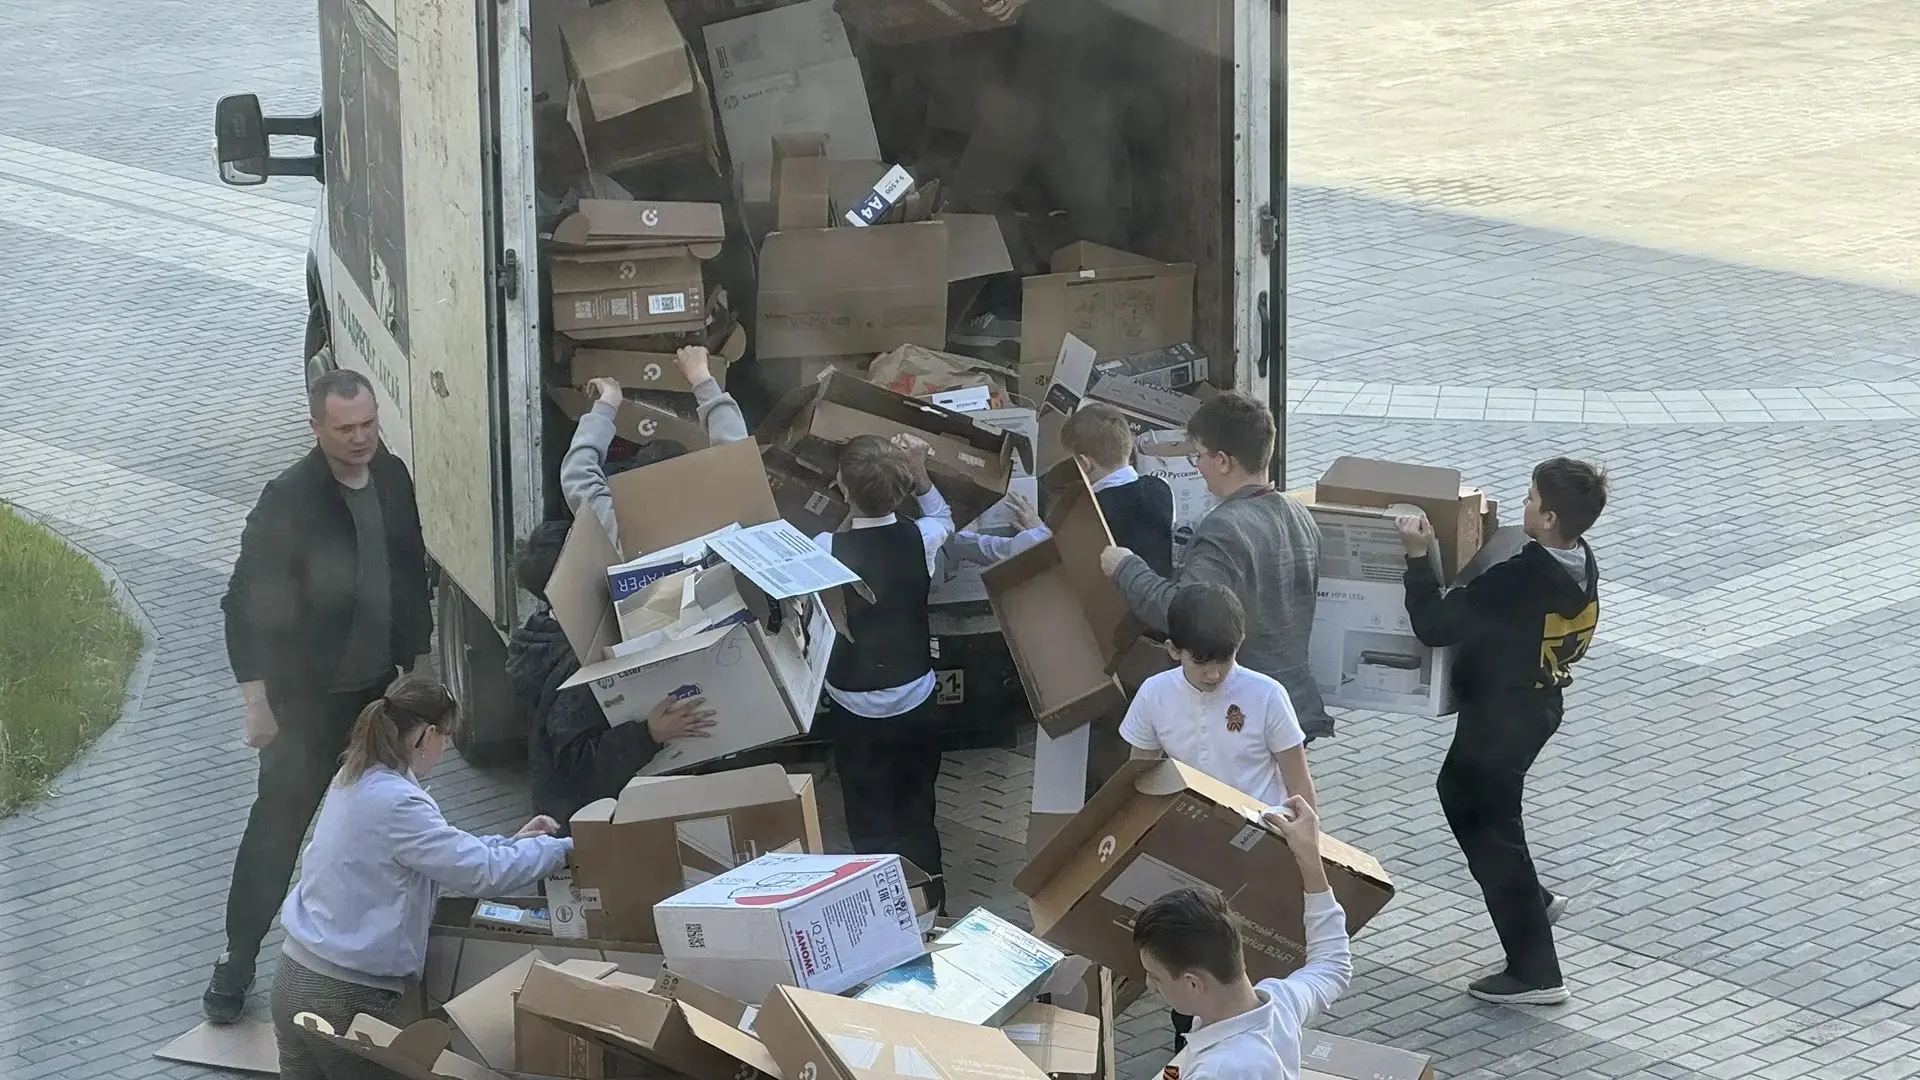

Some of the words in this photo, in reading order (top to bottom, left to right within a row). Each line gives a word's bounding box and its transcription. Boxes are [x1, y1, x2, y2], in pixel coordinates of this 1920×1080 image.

[884, 183, 897, 195] 500
[860, 195, 884, 220] A4
[810, 920, 822, 937] JQ
[795, 929, 816, 977] JANOME
